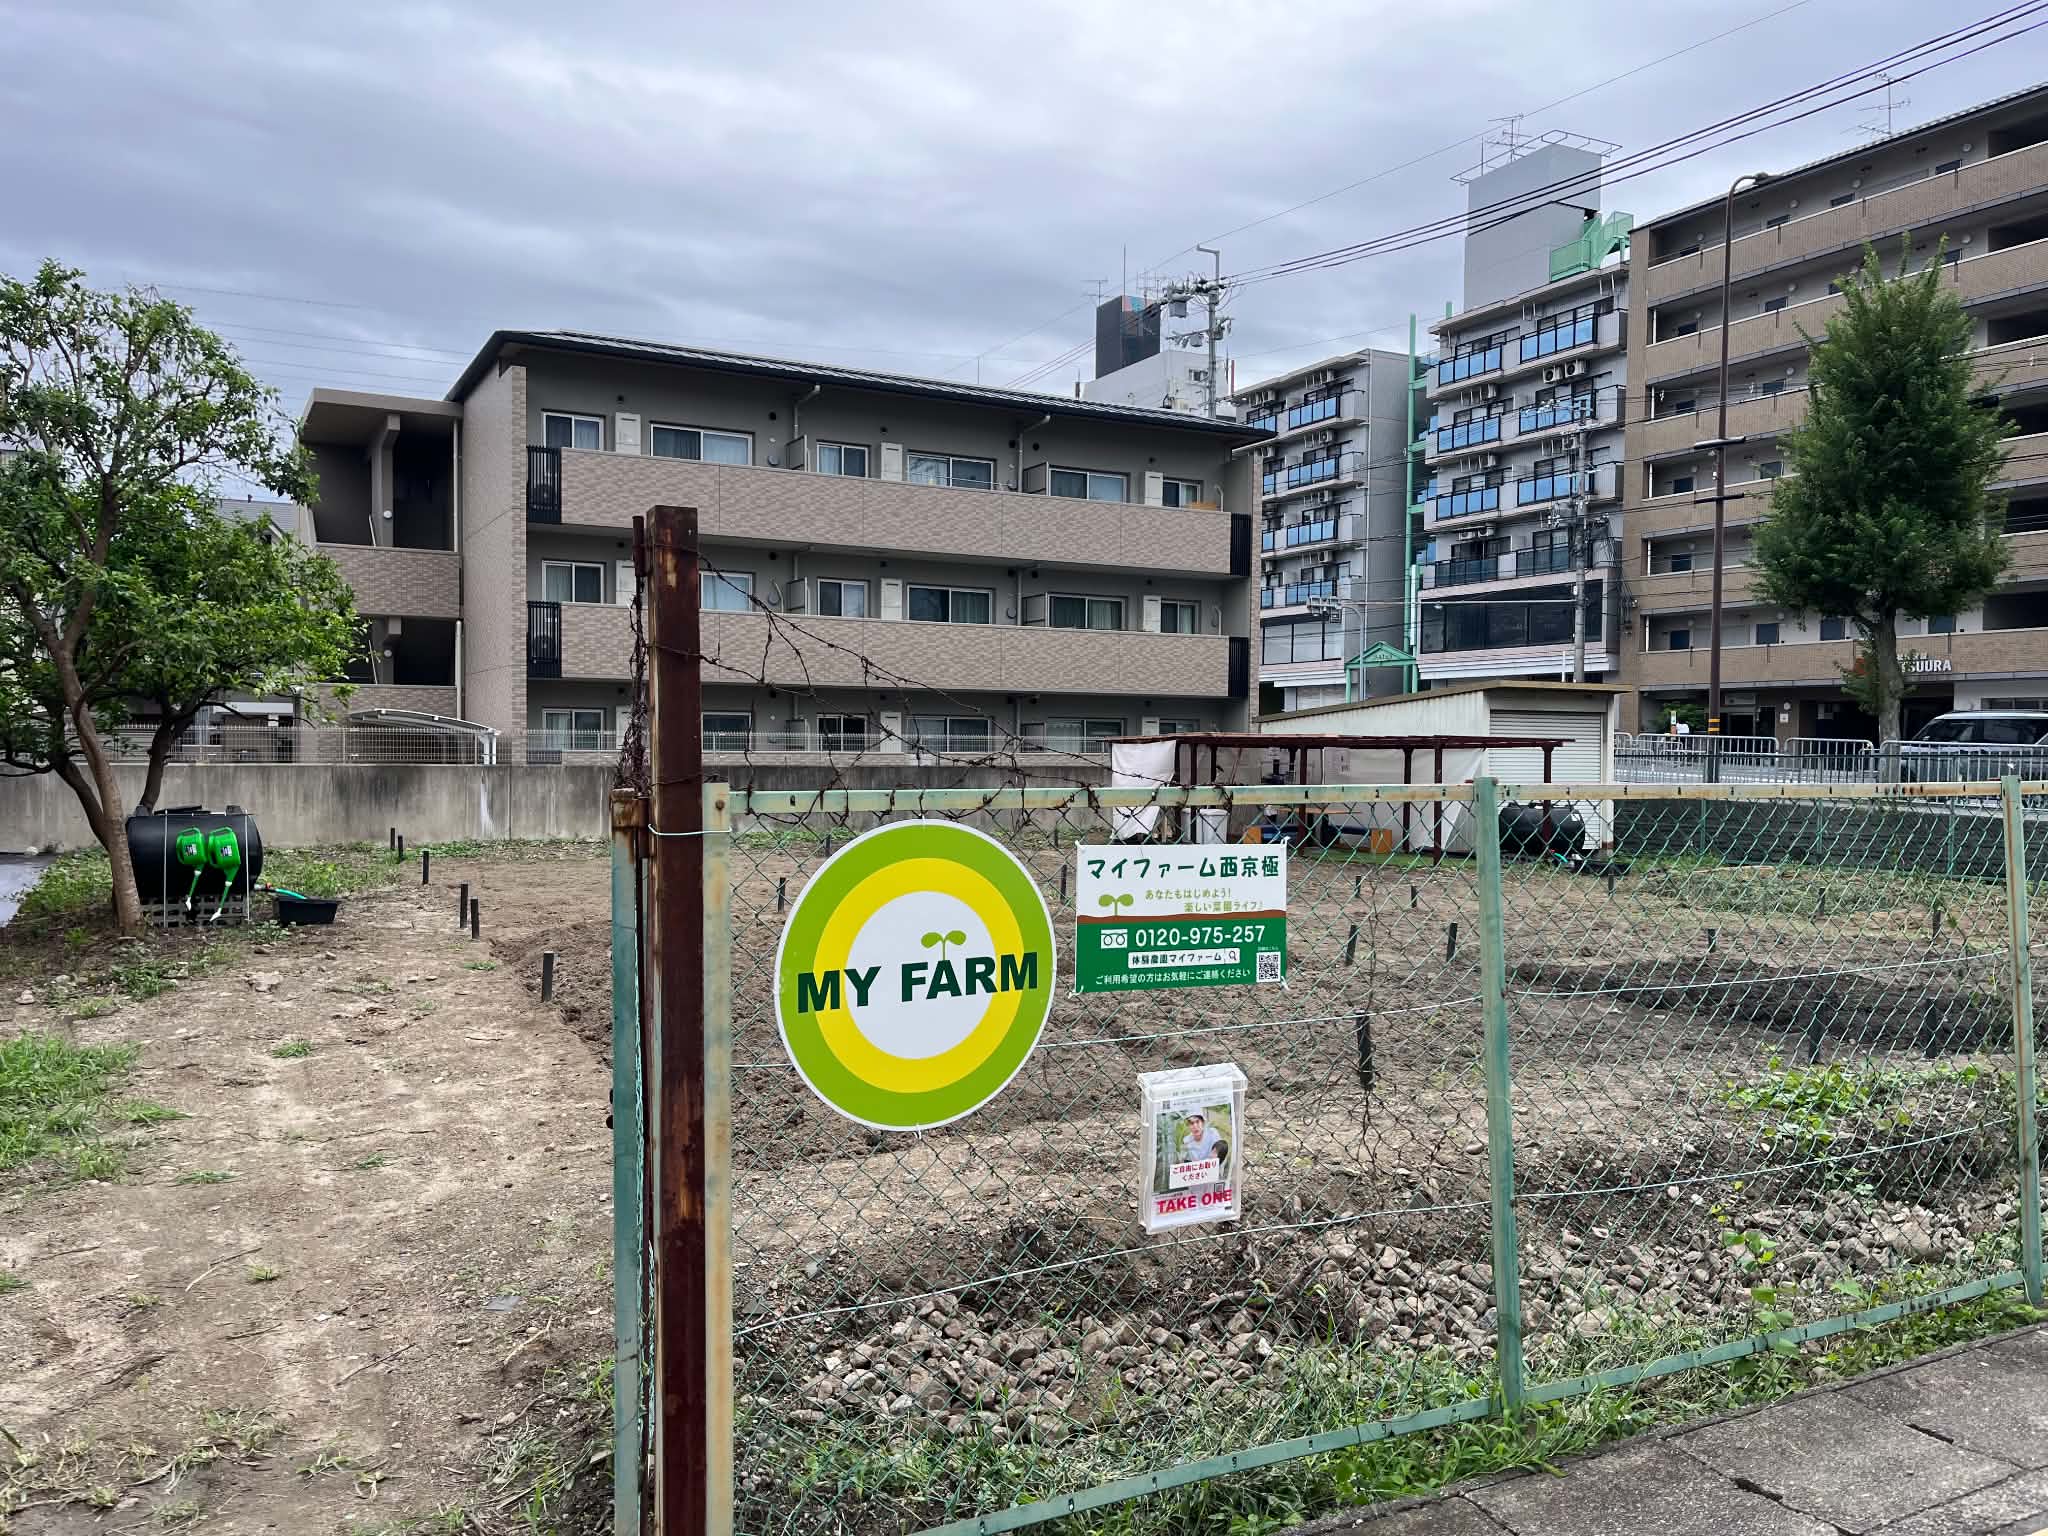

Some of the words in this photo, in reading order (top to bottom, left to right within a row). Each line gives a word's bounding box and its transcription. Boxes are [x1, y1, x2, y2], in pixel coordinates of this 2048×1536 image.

[1087, 855, 1279, 879] マイファーム西京極
[1135, 925, 1266, 947] 0120-975-257
[797, 966, 882, 1013] MY
[901, 952, 1038, 1002] FARM
[1157, 1195, 1197, 1214] TAKE
[1201, 1189, 1233, 1206] ONE
